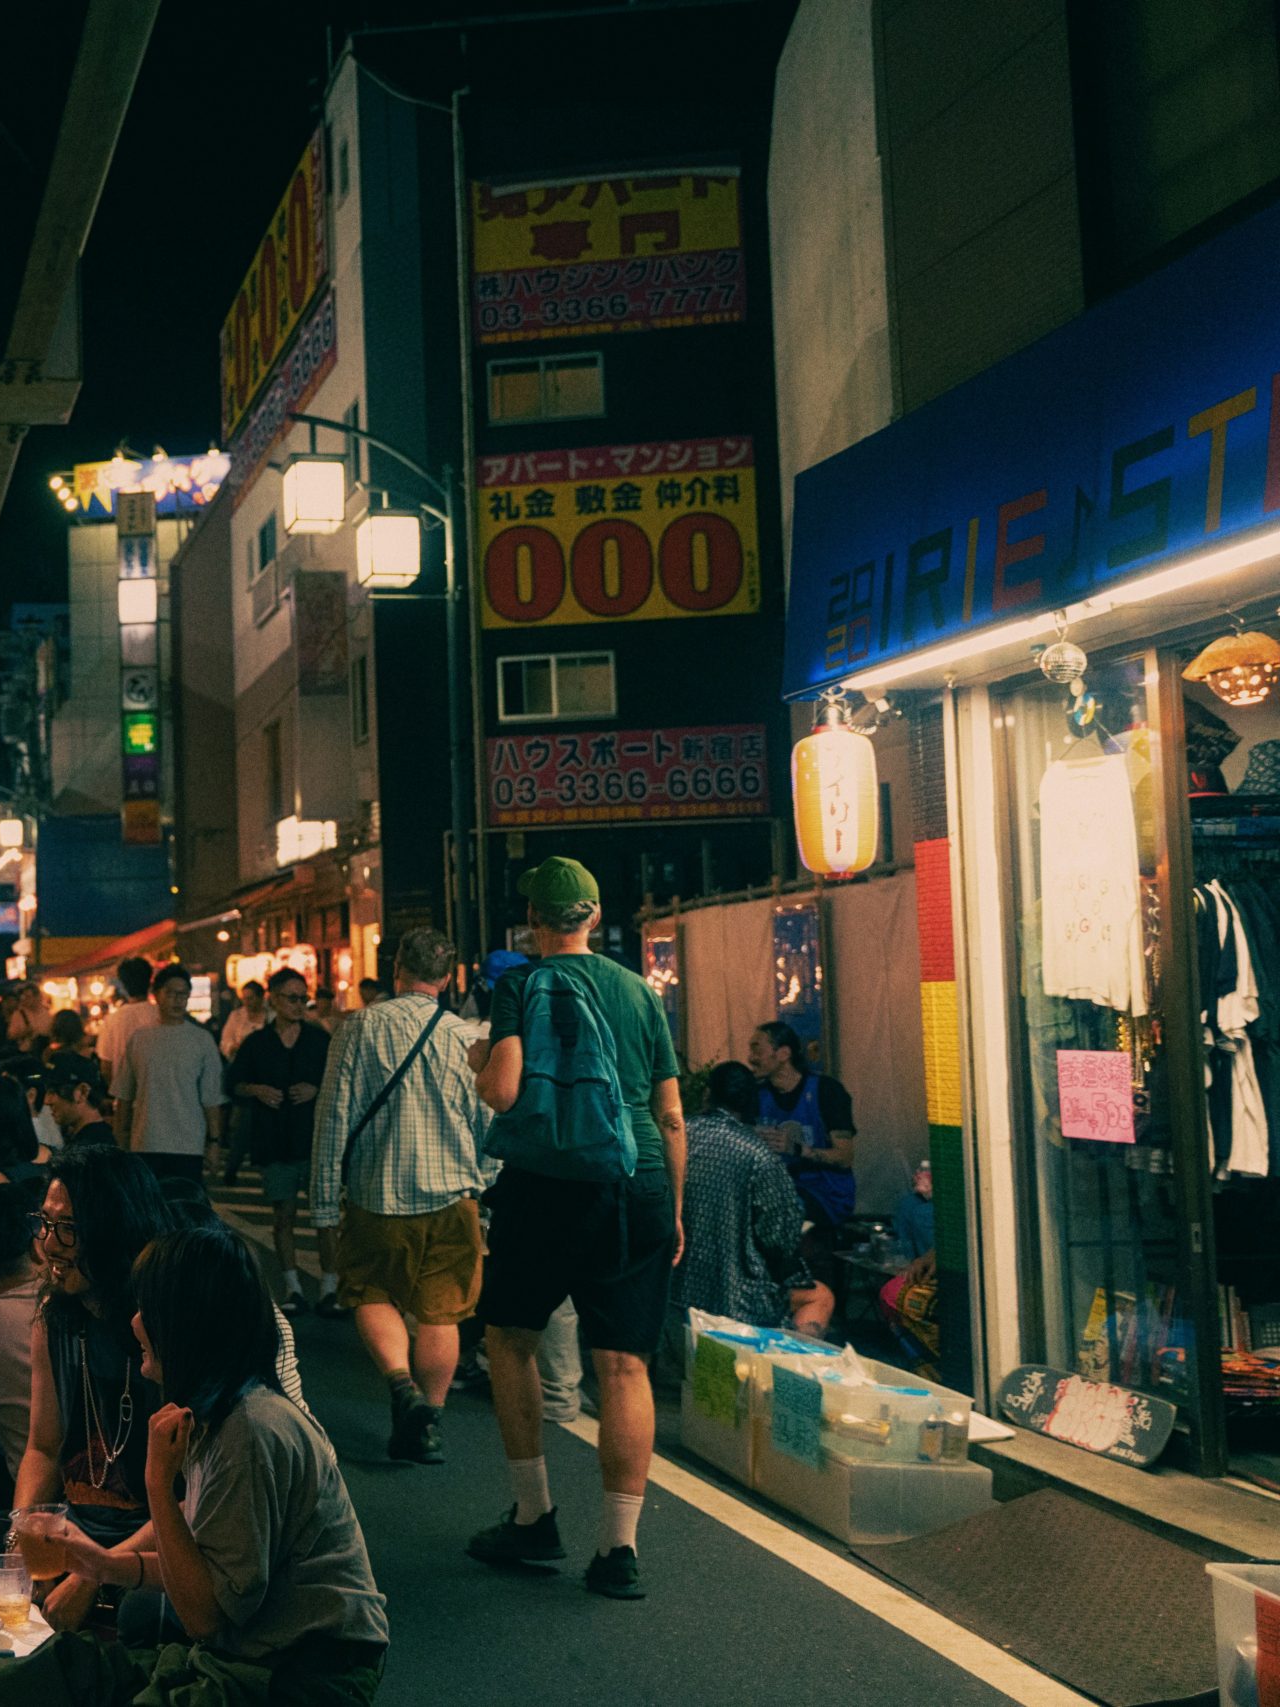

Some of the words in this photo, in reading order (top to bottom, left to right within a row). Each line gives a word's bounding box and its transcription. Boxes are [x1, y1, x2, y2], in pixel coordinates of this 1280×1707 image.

[480, 284, 736, 330] 03-3366-7777
[482, 439, 751, 486] アパート・マンション
[489, 488, 554, 521] 礼金
[575, 482, 642, 515] 敷金
[656, 474, 740, 509] 仲介料
[495, 766, 760, 805] 03-3366-6666
